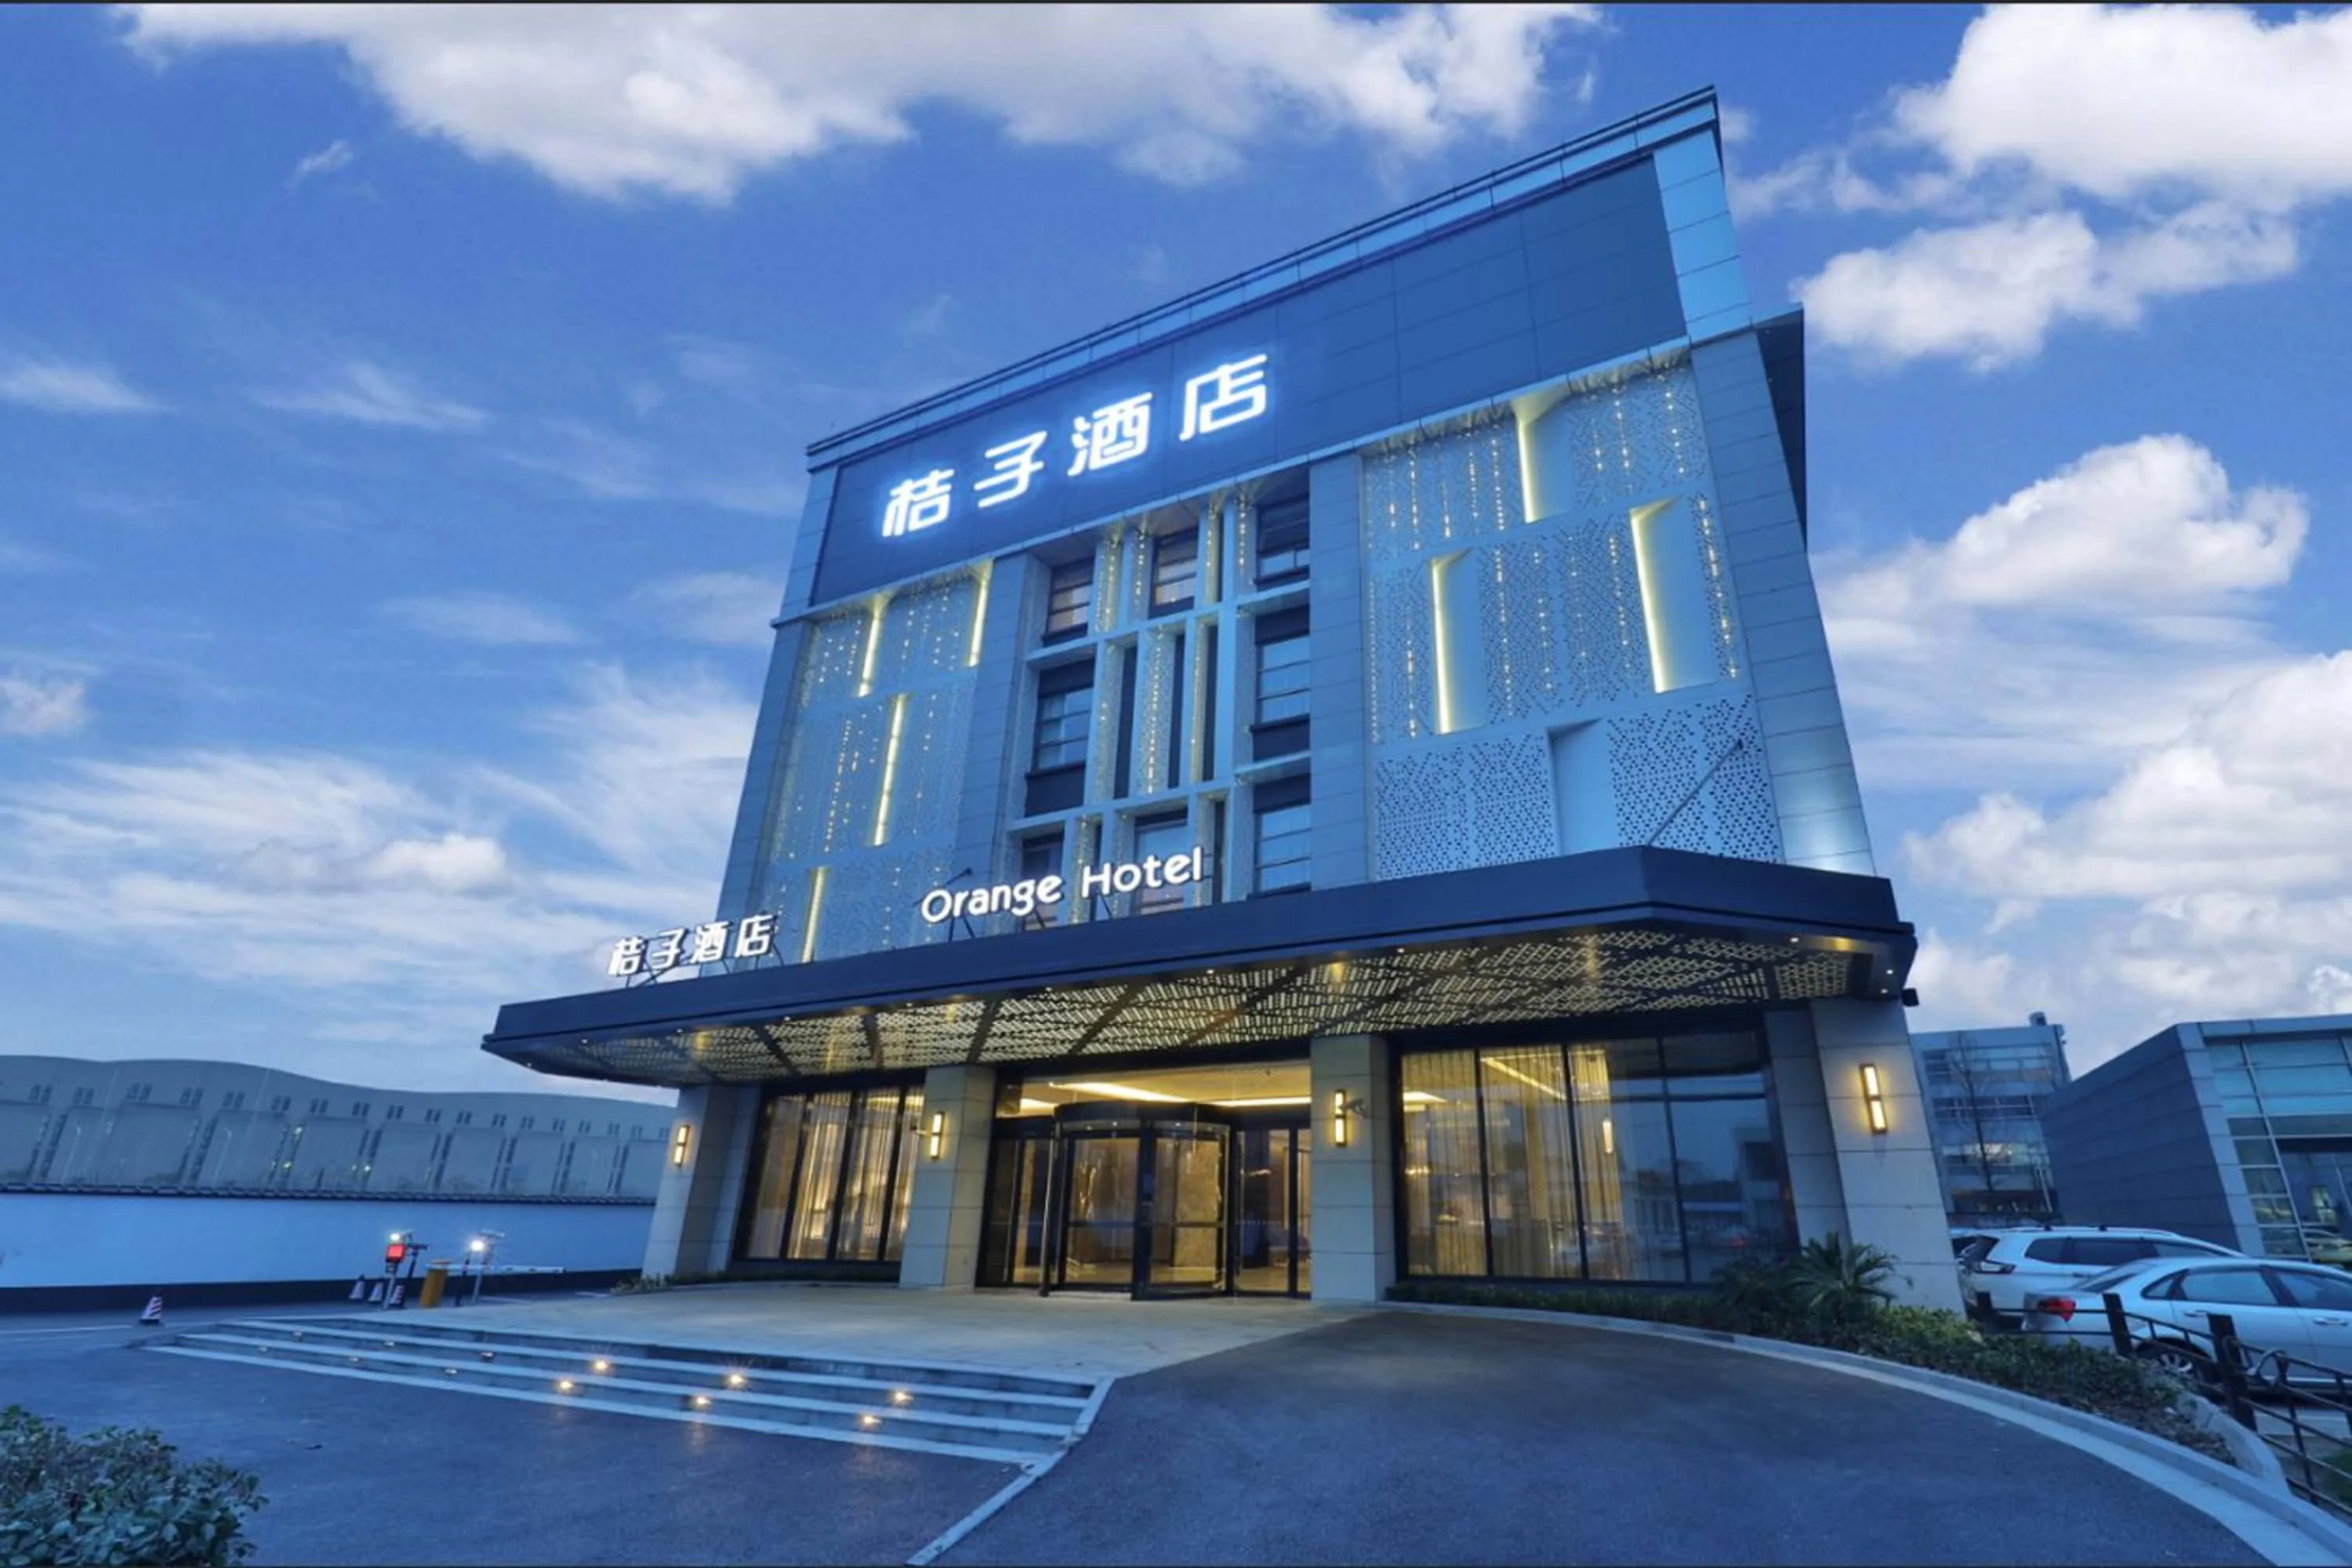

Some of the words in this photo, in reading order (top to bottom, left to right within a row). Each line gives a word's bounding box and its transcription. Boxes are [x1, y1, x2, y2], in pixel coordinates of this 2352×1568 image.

[882, 354, 1268, 537] 桔子酒店
[921, 874, 1063, 924] Orange
[1081, 846, 1203, 898] Hotel
[608, 913, 775, 976] 桔子酒店
